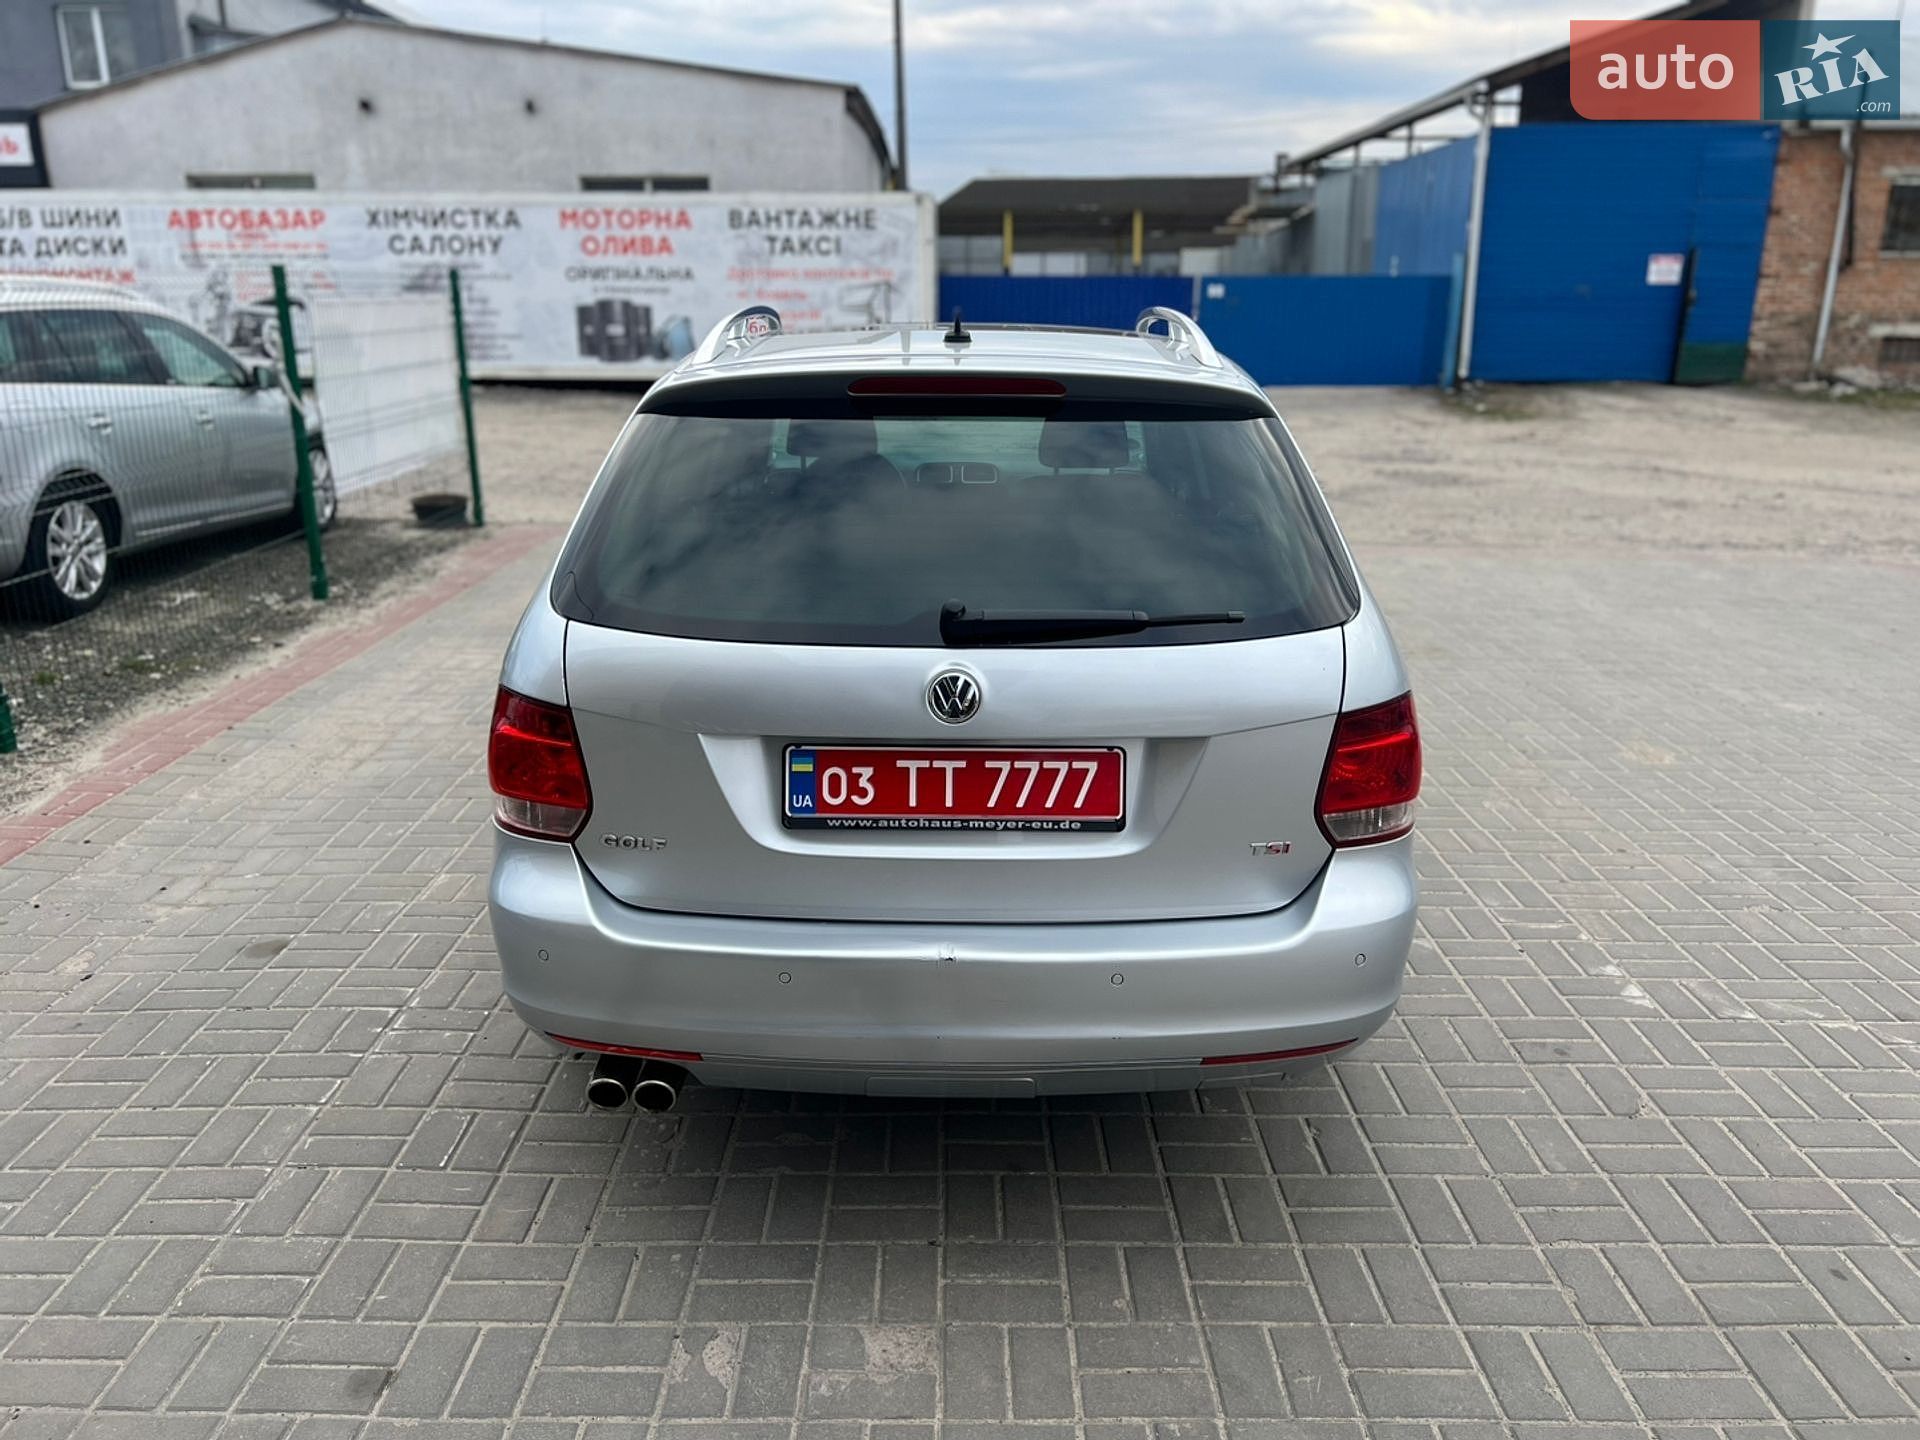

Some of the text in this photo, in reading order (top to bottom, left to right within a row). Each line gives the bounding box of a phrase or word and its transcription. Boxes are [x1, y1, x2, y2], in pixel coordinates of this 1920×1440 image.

[40, 208, 121, 229] ШИНИ
[168, 208, 327, 230] АВТОБАЗАР
[367, 208, 522, 229] ХІМЧИСТКА
[559, 208, 693, 230] МОТОРНА
[728, 209, 877, 230] ВАНТАЖНЕ
[35, 237, 127, 258] ДИСКИ
[388, 234, 503, 255] САЛОНУ
[580, 235, 674, 256] ОЛИВА
[765, 235, 842, 256] ТАКСІ
[792, 760, 1098, 809] UA 03 TT 7777
[827, 818, 1082, 831] www.autohaus-meyer-eu.de
[600, 834, 667, 851] GOLF
[1248, 841, 1291, 856] TSI
